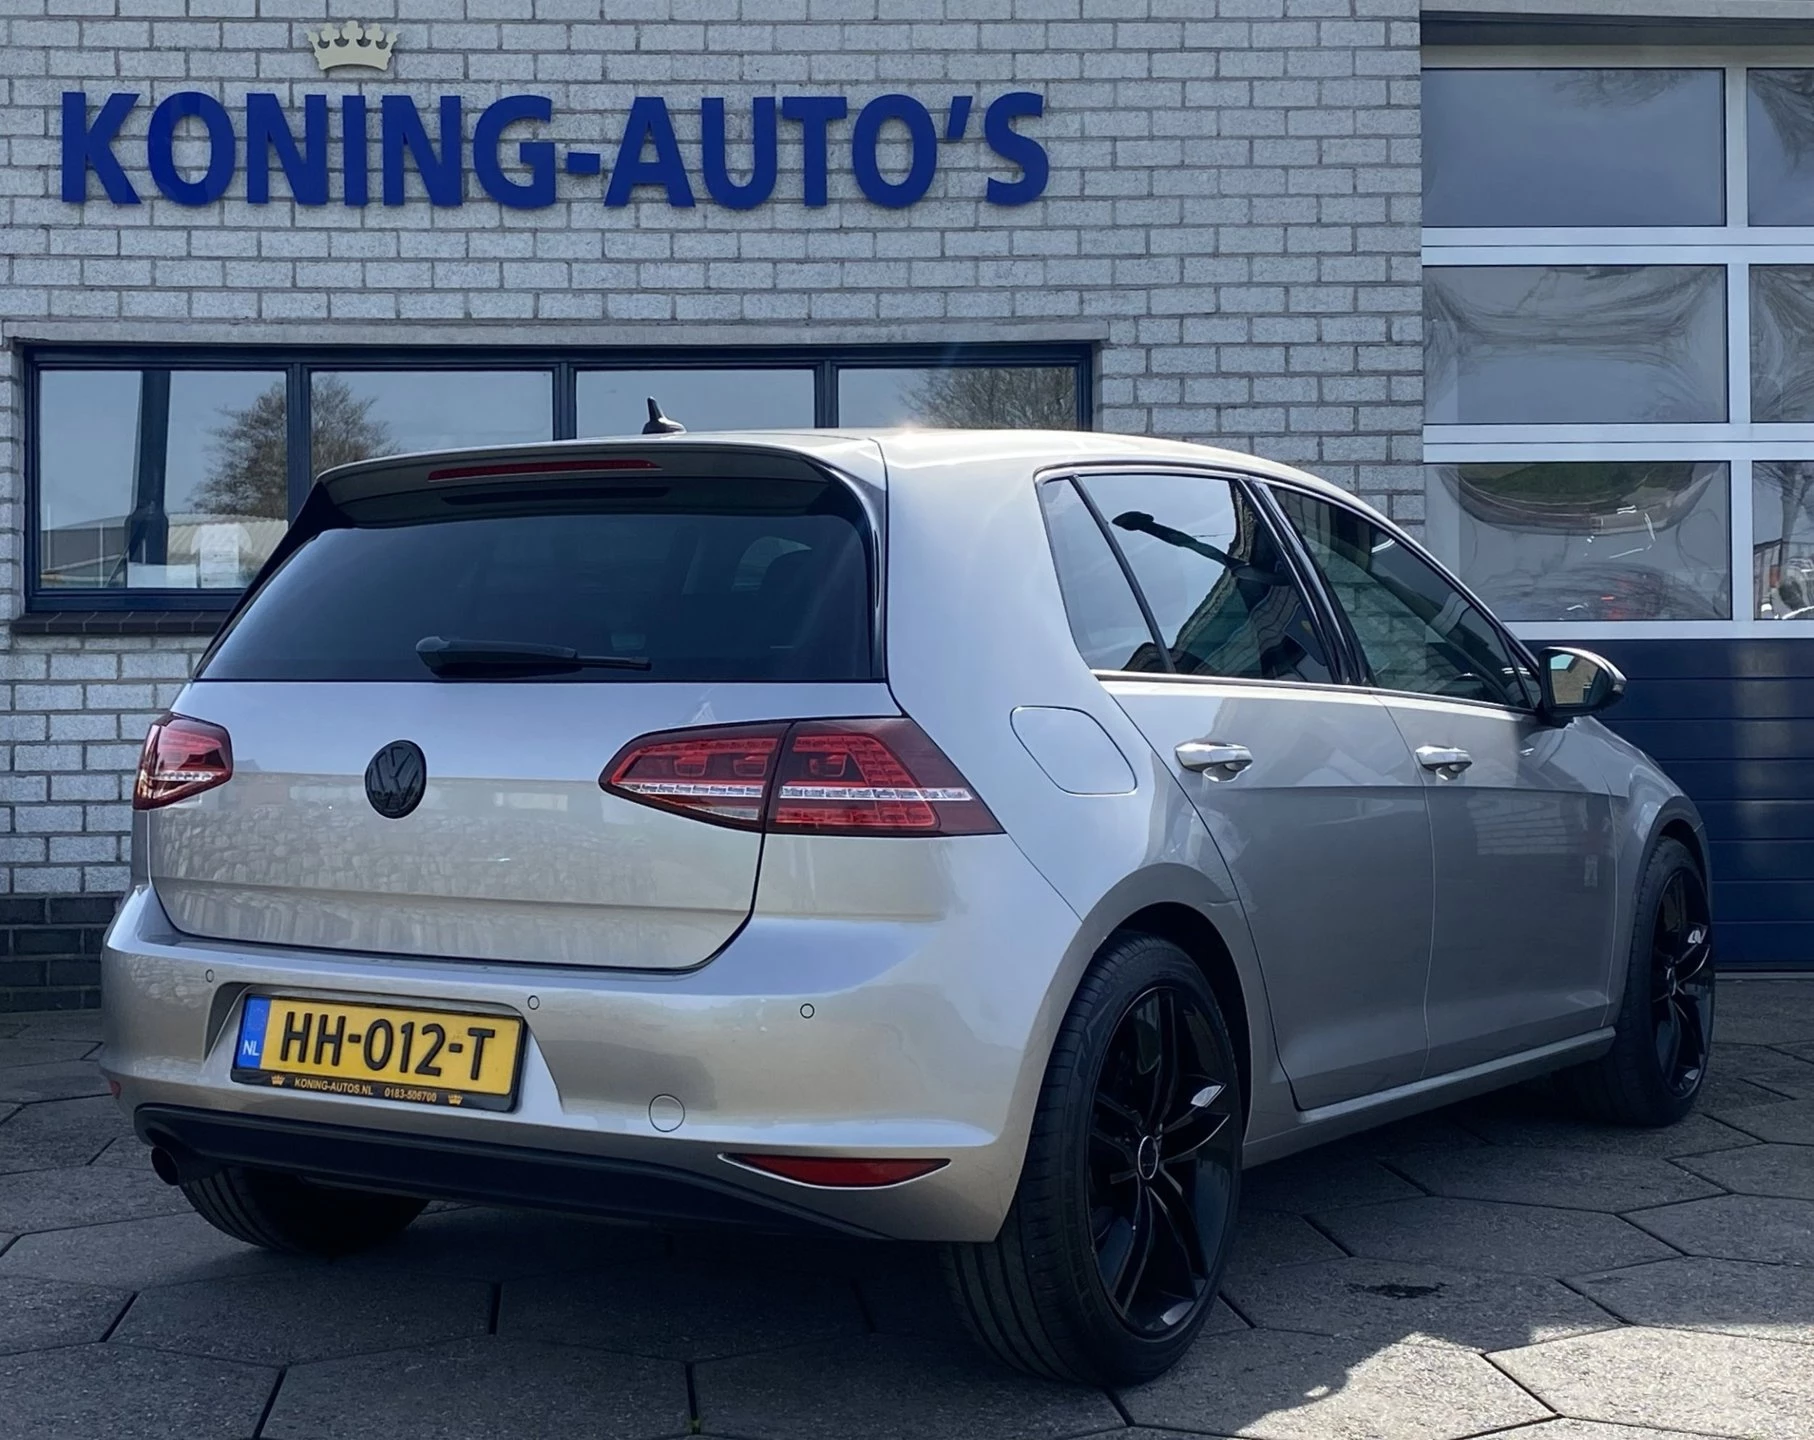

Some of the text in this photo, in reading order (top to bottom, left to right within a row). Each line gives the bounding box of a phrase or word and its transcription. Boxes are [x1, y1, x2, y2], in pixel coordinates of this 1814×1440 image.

[62, 90, 1049, 209] KONING-AUTO'S
[242, 1040, 260, 1057] NL
[280, 1012, 495, 1080] HH-012-T
[294, 1078, 373, 1096] KONING-AUTOS.NL
